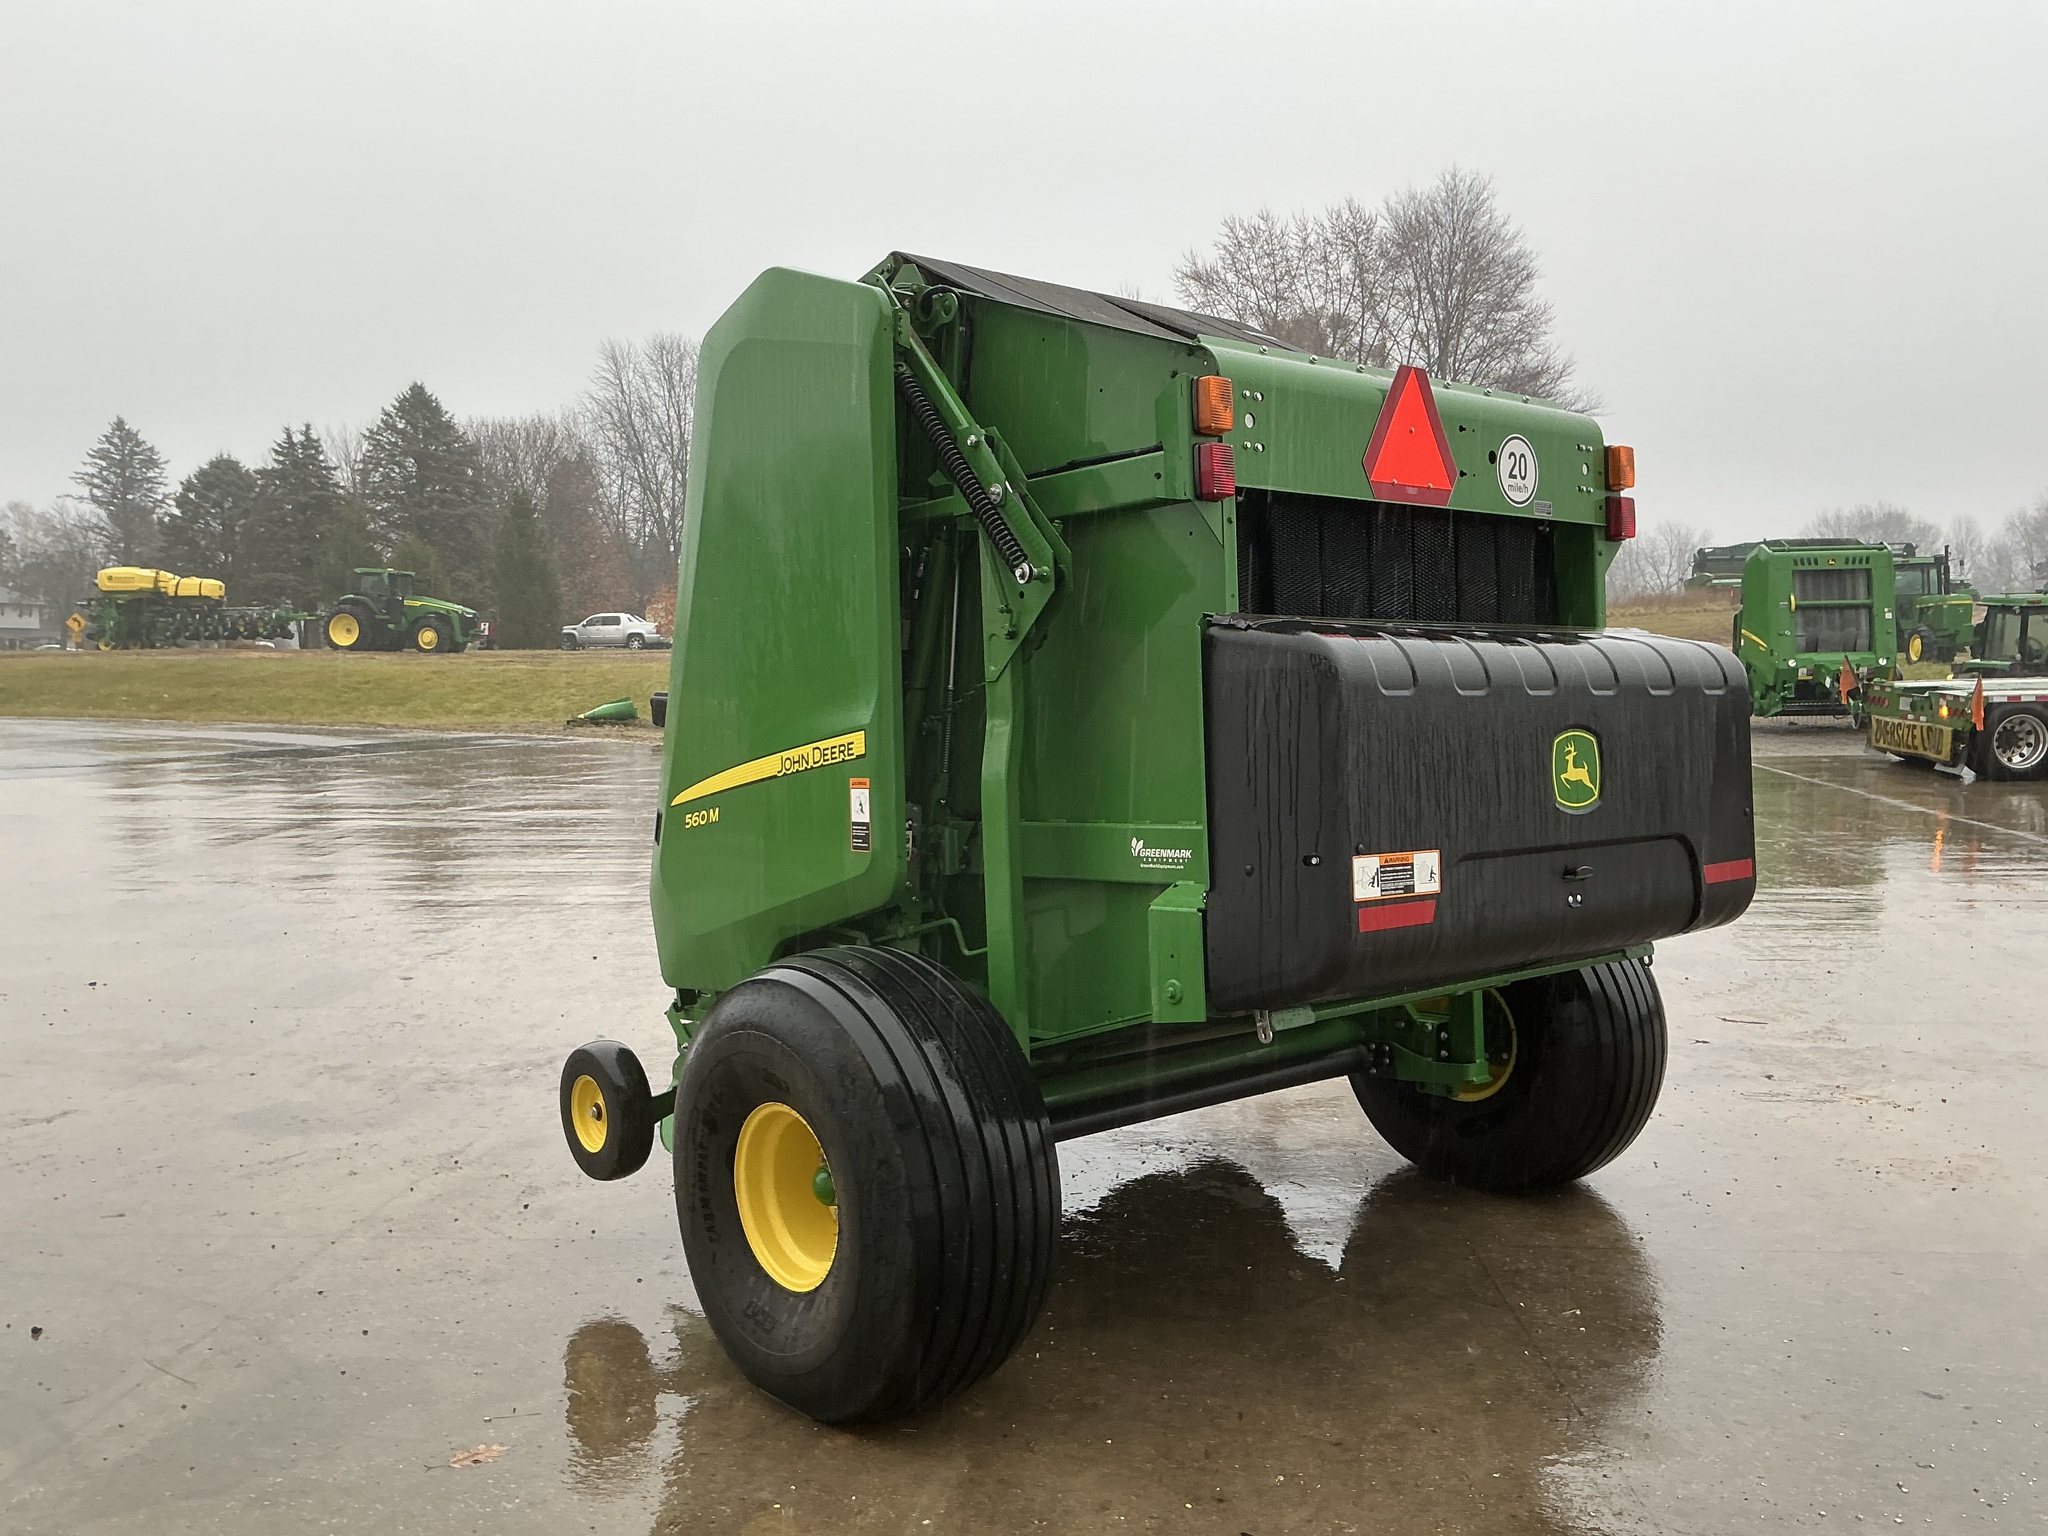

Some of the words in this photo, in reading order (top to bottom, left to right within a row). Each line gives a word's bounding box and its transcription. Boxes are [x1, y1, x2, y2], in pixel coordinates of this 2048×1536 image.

[1507, 451, 1527, 481] 20
[1507, 482, 1529, 494] mile/h
[1875, 718, 1919, 751] OVERSIZE
[777, 752, 810, 775] JOHN
[812, 741, 855, 765] DEERE
[685, 811, 708, 829] 560
[709, 806, 720, 823] M
[1140, 848, 1193, 859] GREENMARK
